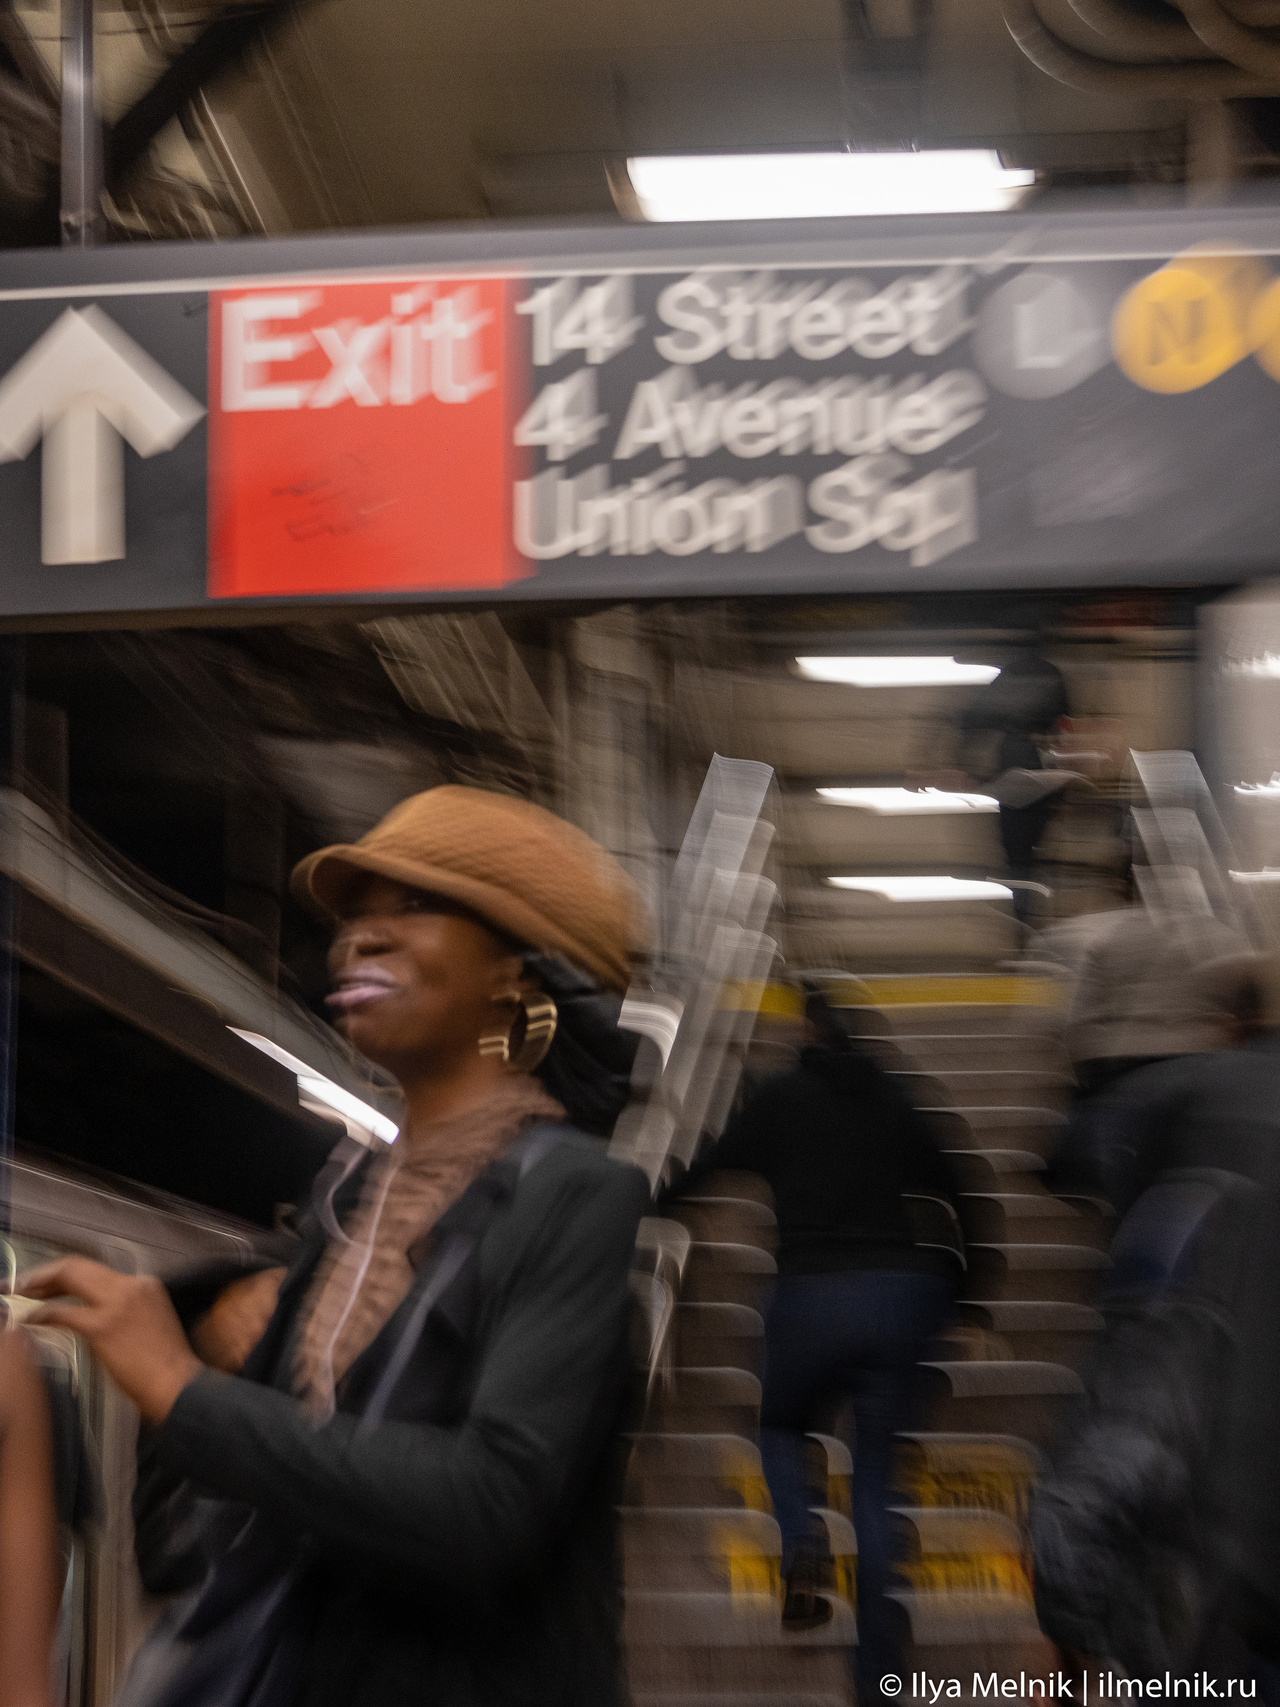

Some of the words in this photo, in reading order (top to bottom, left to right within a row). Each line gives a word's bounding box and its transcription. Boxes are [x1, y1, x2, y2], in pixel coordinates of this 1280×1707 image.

[222, 284, 496, 412] Exit
[515, 270, 638, 365] 14
[654, 262, 970, 363] Street
[1144, 298, 1214, 369] N
[514, 368, 606, 460] 4
[613, 366, 986, 460] Avenue
[513, 460, 807, 560] Union
[806, 452, 978, 566] Sq
